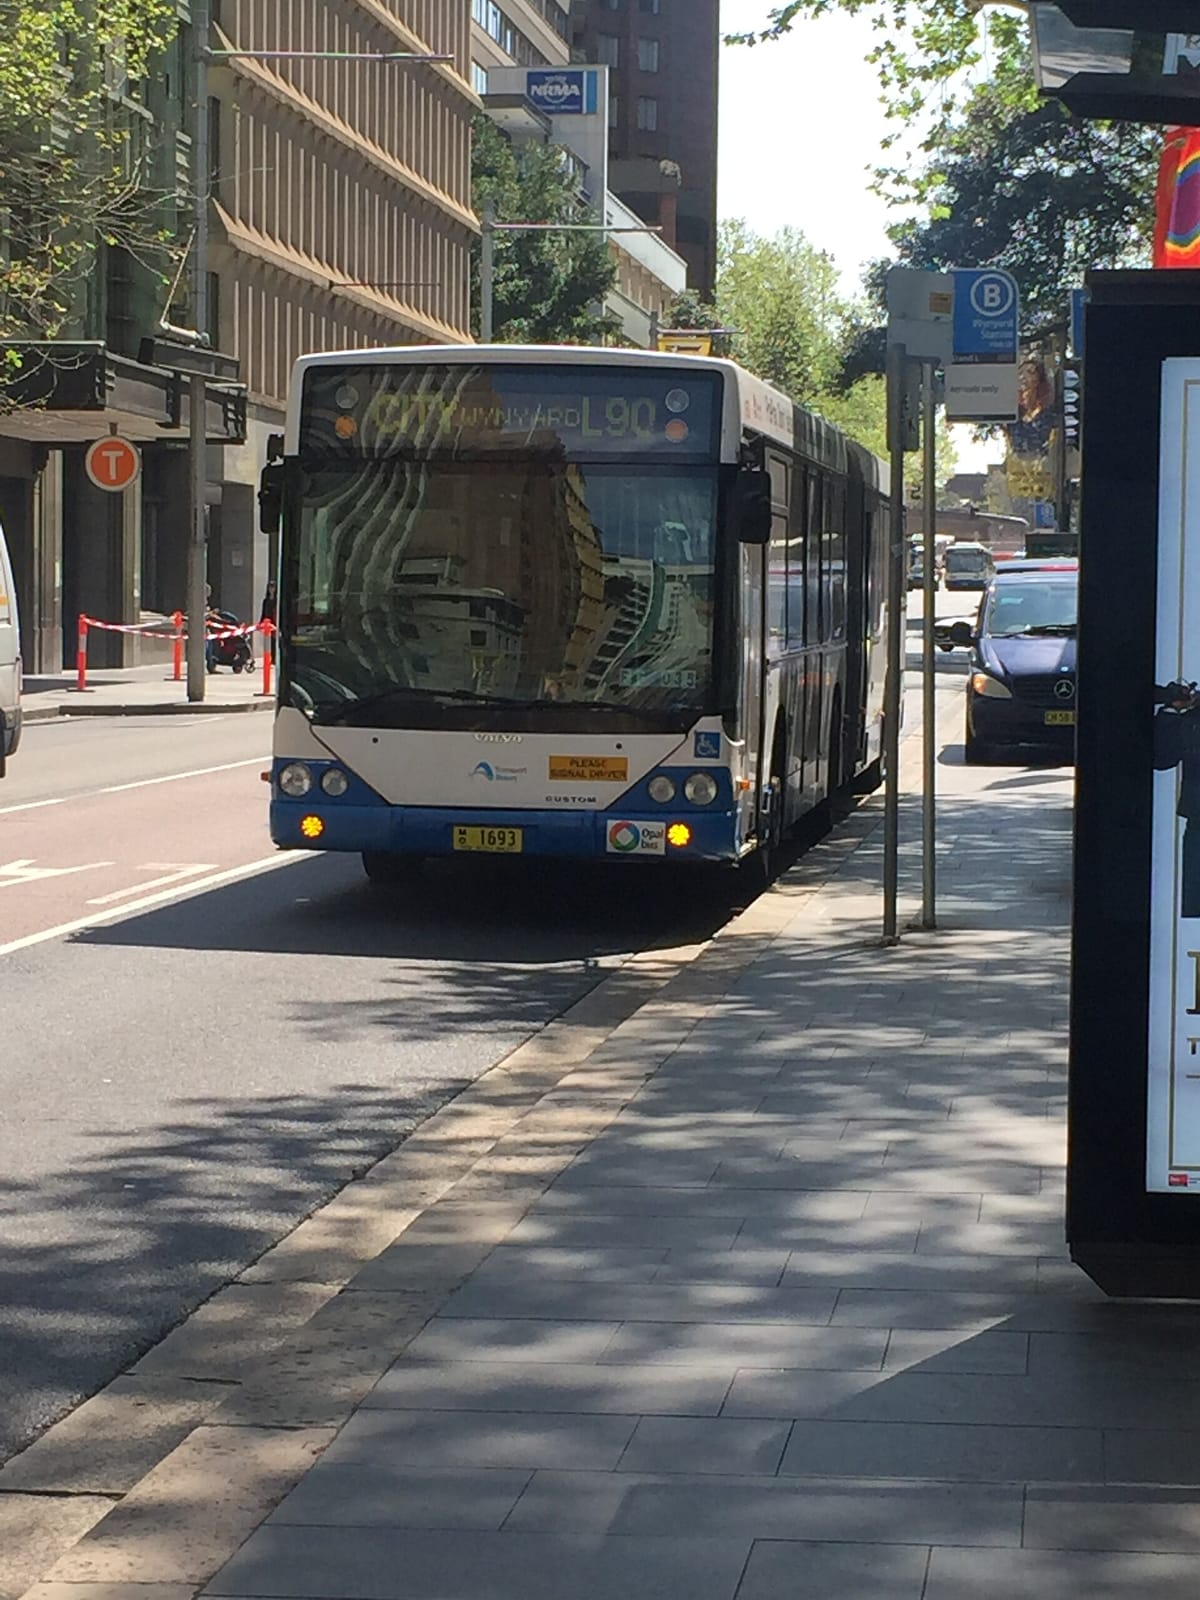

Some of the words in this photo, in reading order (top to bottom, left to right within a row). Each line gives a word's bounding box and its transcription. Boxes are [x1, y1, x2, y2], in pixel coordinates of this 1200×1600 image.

[531, 84, 580, 97] NRMA
[983, 283, 1001, 307] B
[370, 393, 458, 434] CITY
[460, 406, 581, 427] WYNYARD
[581, 395, 656, 438] L90
[102, 450, 124, 481] T
[473, 733, 524, 744] VOLVO
[569, 758, 607, 769] PLEASE
[550, 768, 587, 779] SIGNAL
[589, 769, 627, 779] DRIVER
[545, 795, 597, 803] CUSTOM
[481, 829, 516, 847] 1693
[641, 826, 665, 841] Opal
[641, 840, 658, 849] bus
